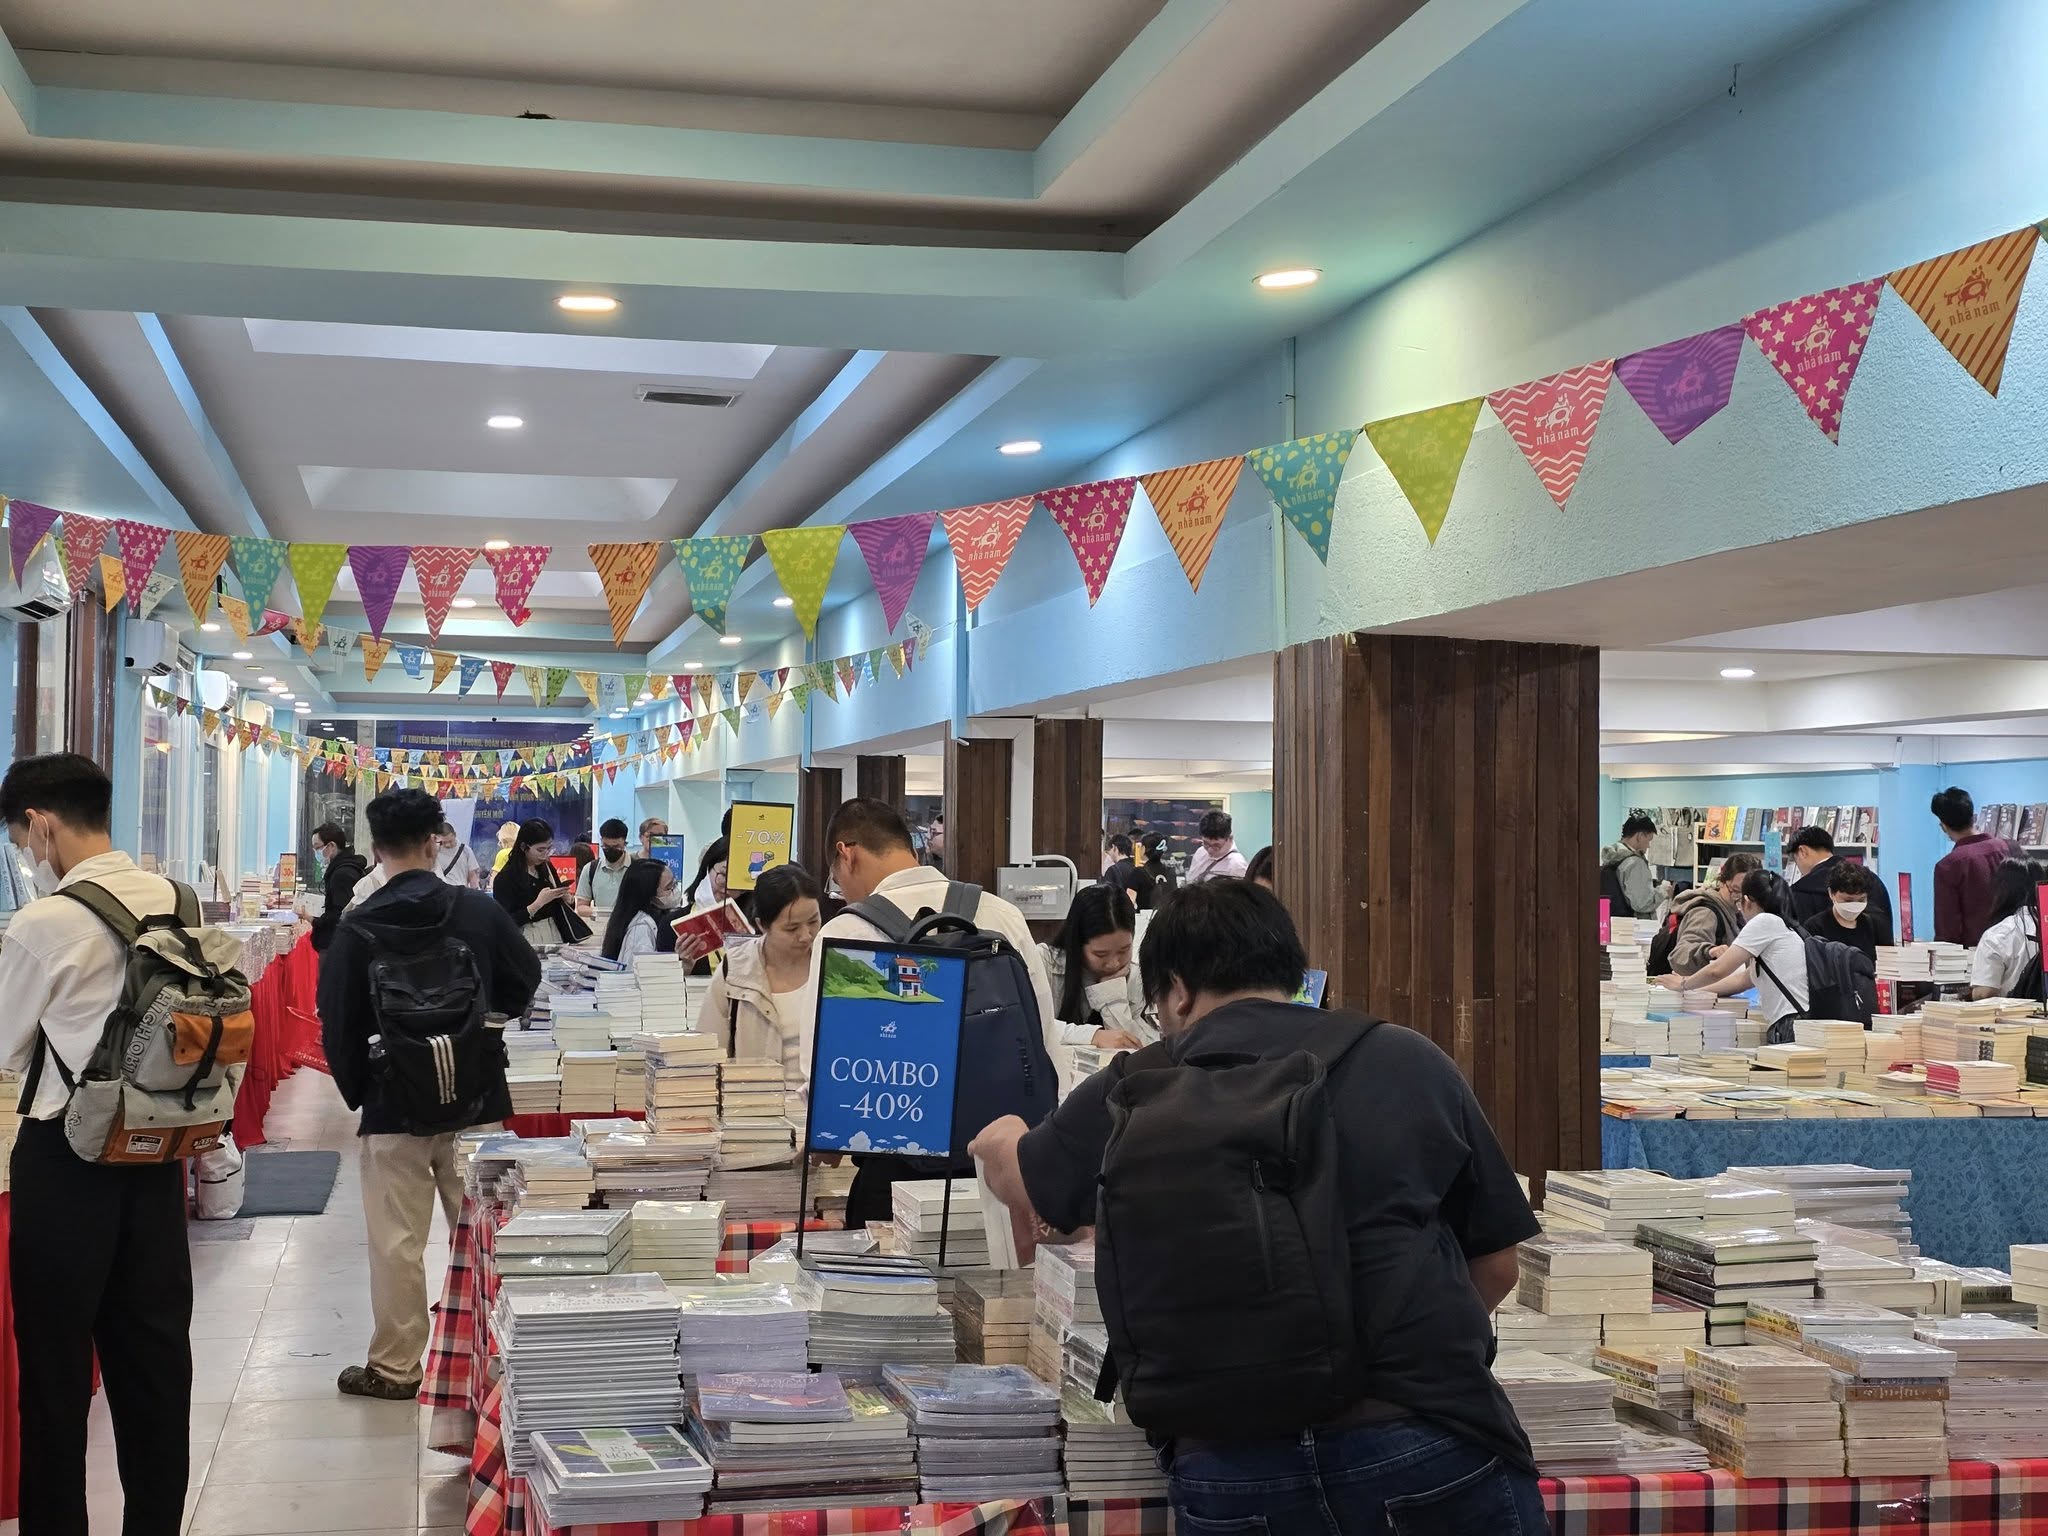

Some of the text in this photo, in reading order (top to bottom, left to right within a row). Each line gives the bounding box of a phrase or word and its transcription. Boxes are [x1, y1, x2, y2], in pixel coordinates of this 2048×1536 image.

[1973, 301, 2000, 318] nam
[1557, 426, 1579, 441] nam
[737, 829, 786, 846] -70%
[830, 1056, 939, 1088] COMBO
[839, 1091, 924, 1122] -40%
